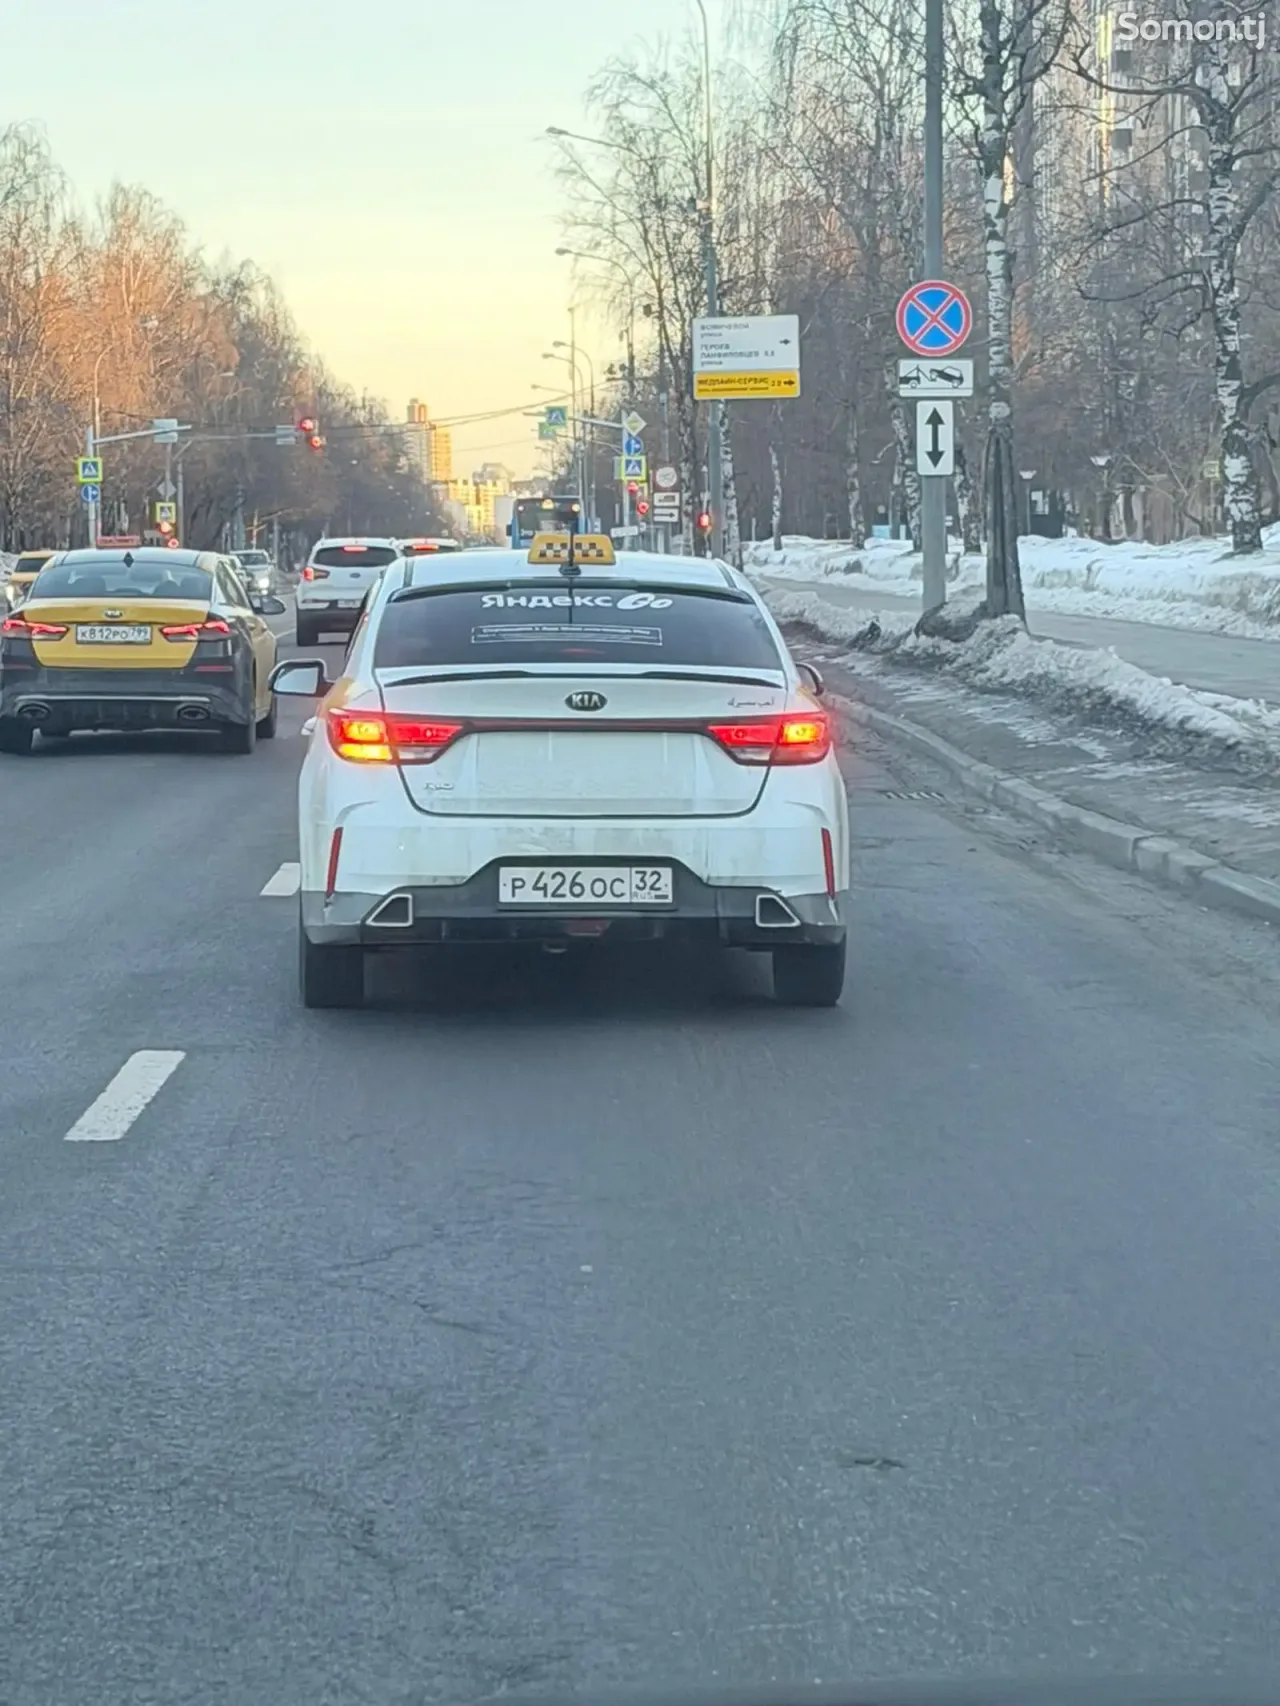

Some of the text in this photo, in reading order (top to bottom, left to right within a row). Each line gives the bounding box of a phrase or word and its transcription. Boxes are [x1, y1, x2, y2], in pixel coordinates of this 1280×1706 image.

[481, 592, 674, 610] Яндекс Go
[571, 694, 601, 707] KIA
[634, 870, 662, 891] 32
